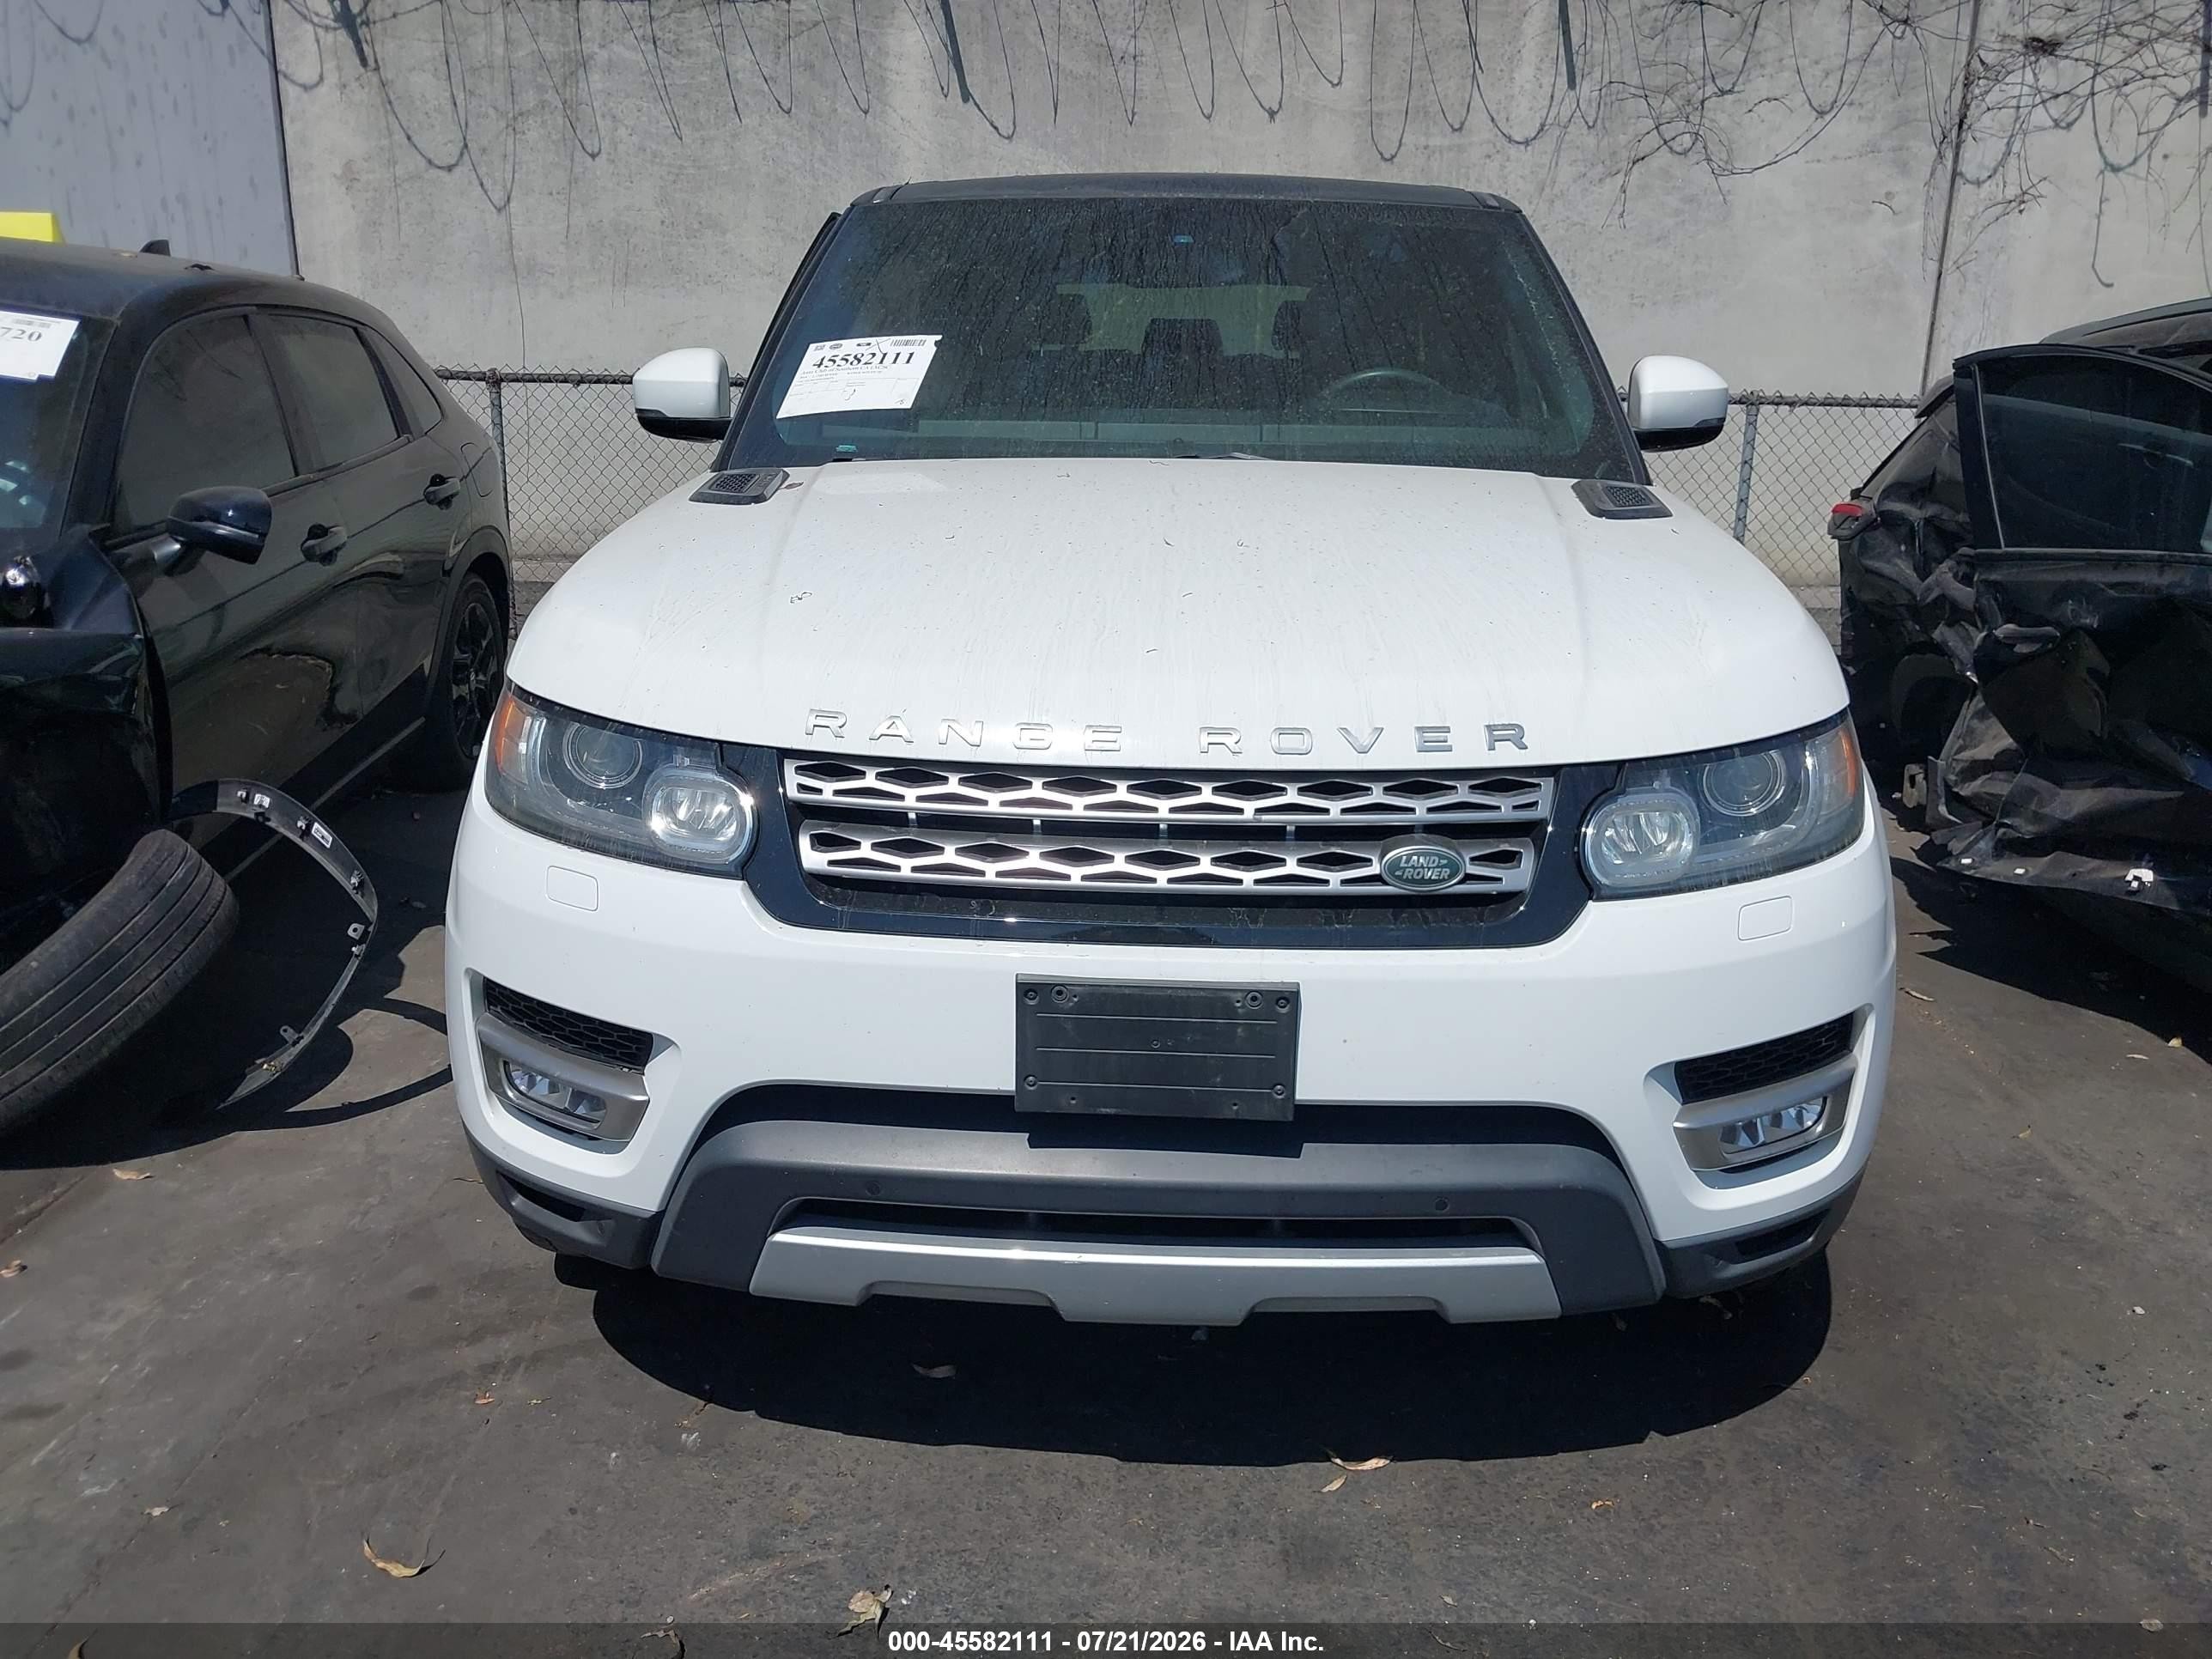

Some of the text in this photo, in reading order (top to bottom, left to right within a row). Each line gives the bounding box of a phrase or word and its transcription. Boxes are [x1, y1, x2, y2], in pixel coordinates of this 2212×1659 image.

[812, 351, 915, 368] 45582111
[805, 708, 1528, 755] RANGE ROVER
[1400, 855, 1439, 867] LAND
[1402, 868, 1450, 879] ROVER
